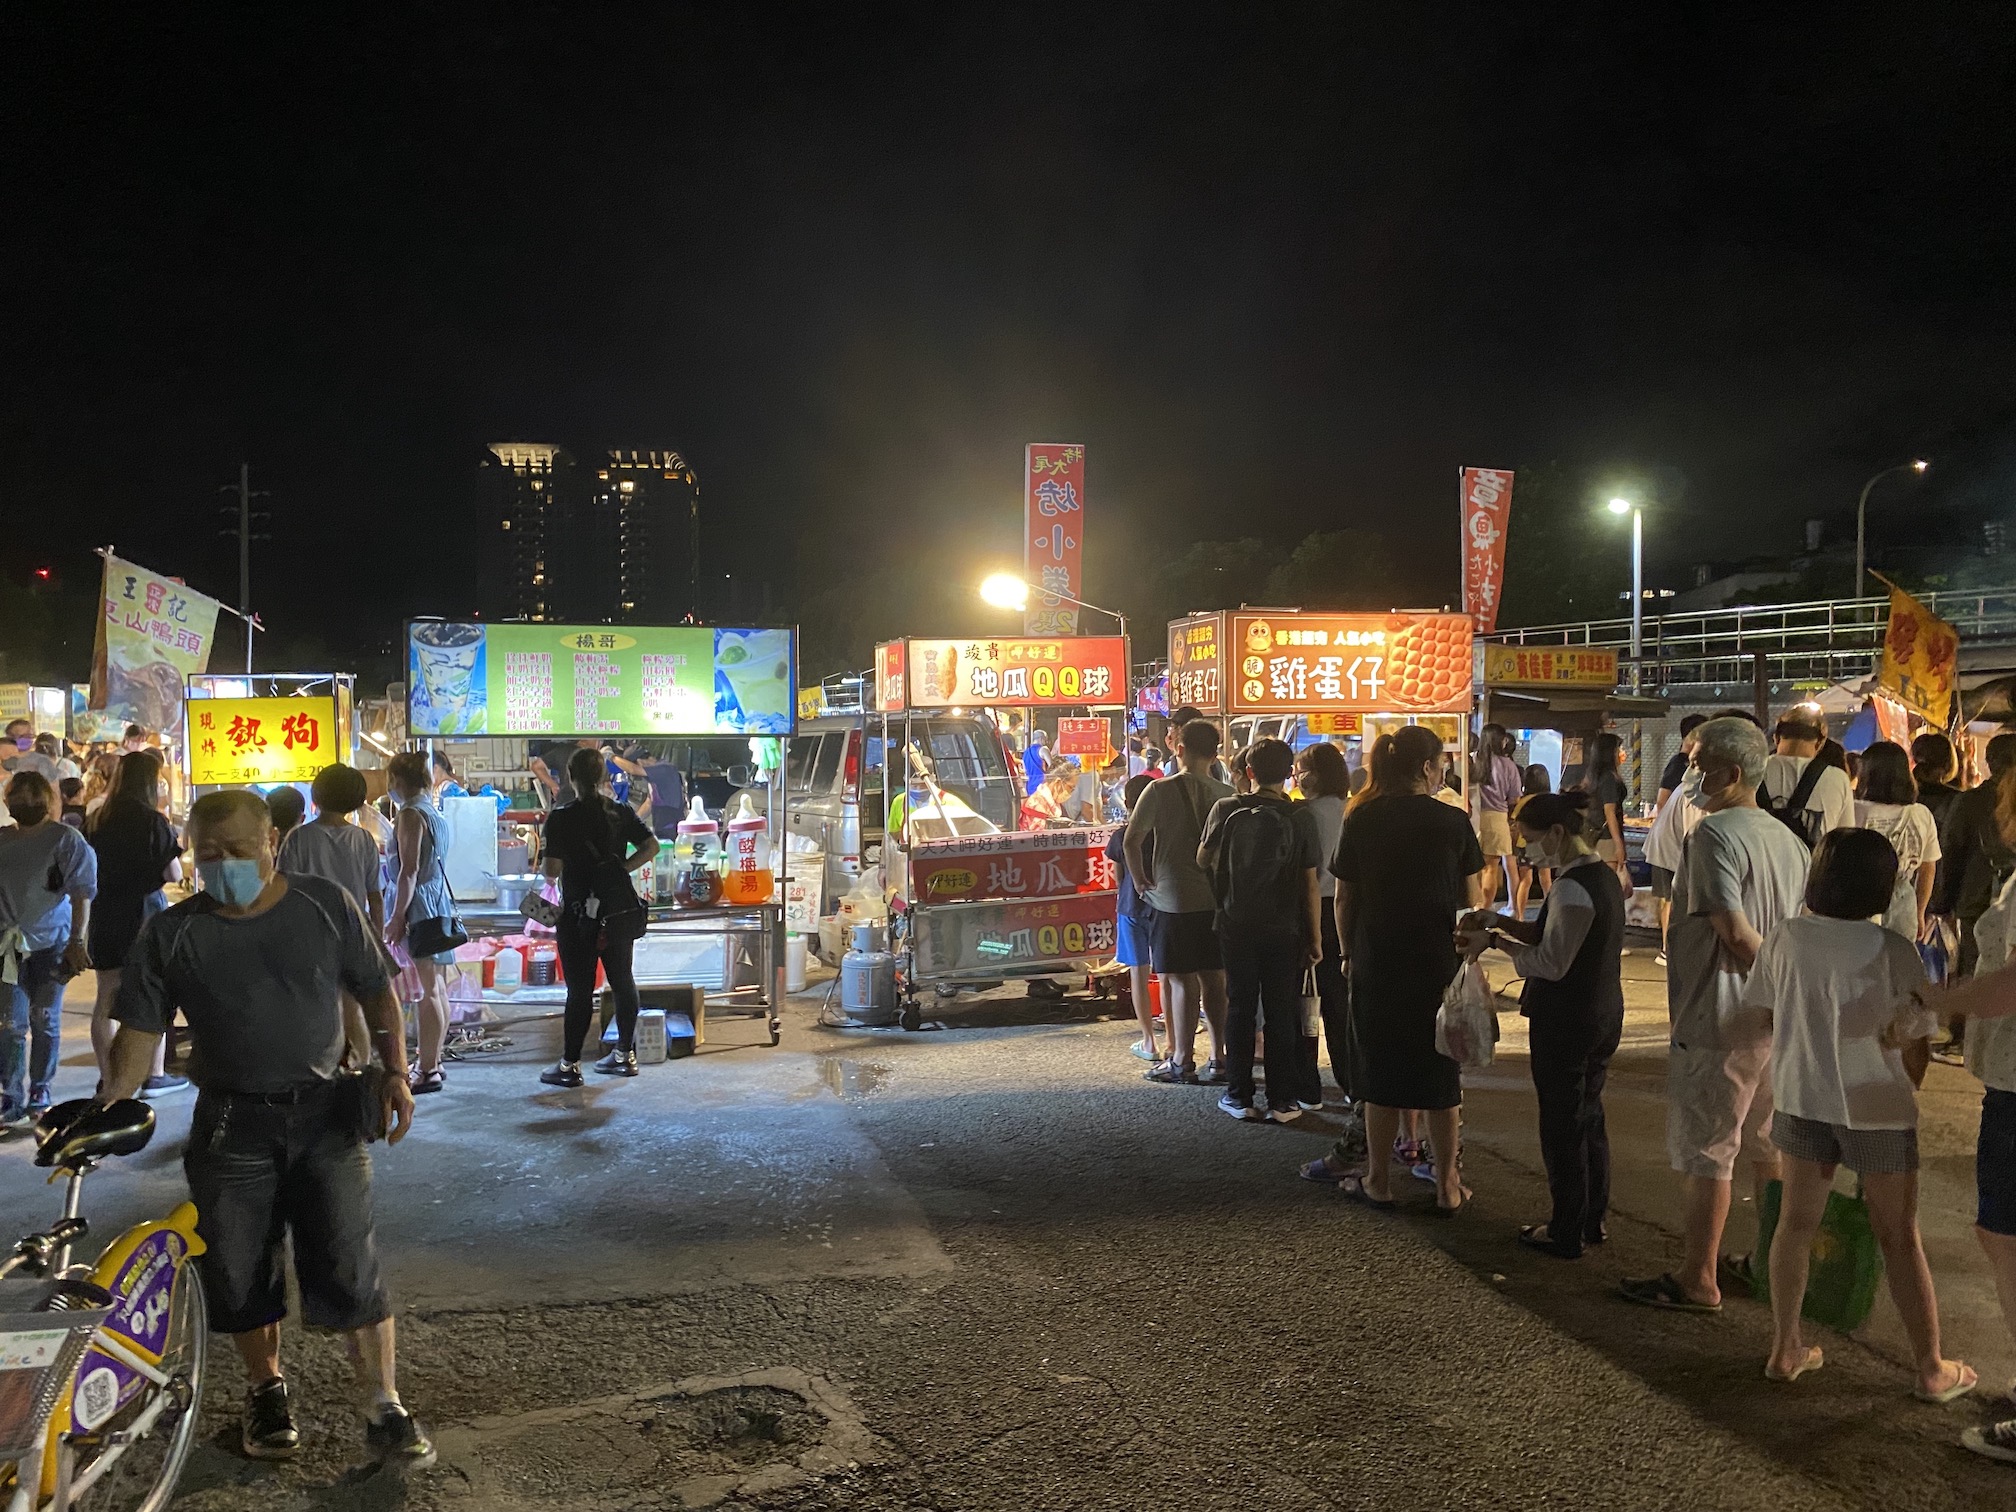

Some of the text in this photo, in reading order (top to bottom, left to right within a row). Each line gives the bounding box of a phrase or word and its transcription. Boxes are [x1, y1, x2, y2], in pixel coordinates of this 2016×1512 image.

[576, 633, 616, 649] 楊哥
[965, 642, 999, 661] 竣貴
[970, 665, 1111, 699] 地瓜QQ球
[1180, 668, 1218, 704] 雞蛋仔
[1246, 659, 1262, 700] 脆皮
[1269, 655, 1386, 700] 雞蛋仔
[200, 711, 217, 758] 現炸
[225, 711, 319, 757] 熱狗
[1033, 828, 1117, 849] 時時得好
[690, 842, 711, 902] 冬瓜茶
[738, 837, 758, 893] 酸梅湯
[986, 850, 1119, 895] 地瓜球
[977, 919, 1114, 961] 地瓜QQ球
